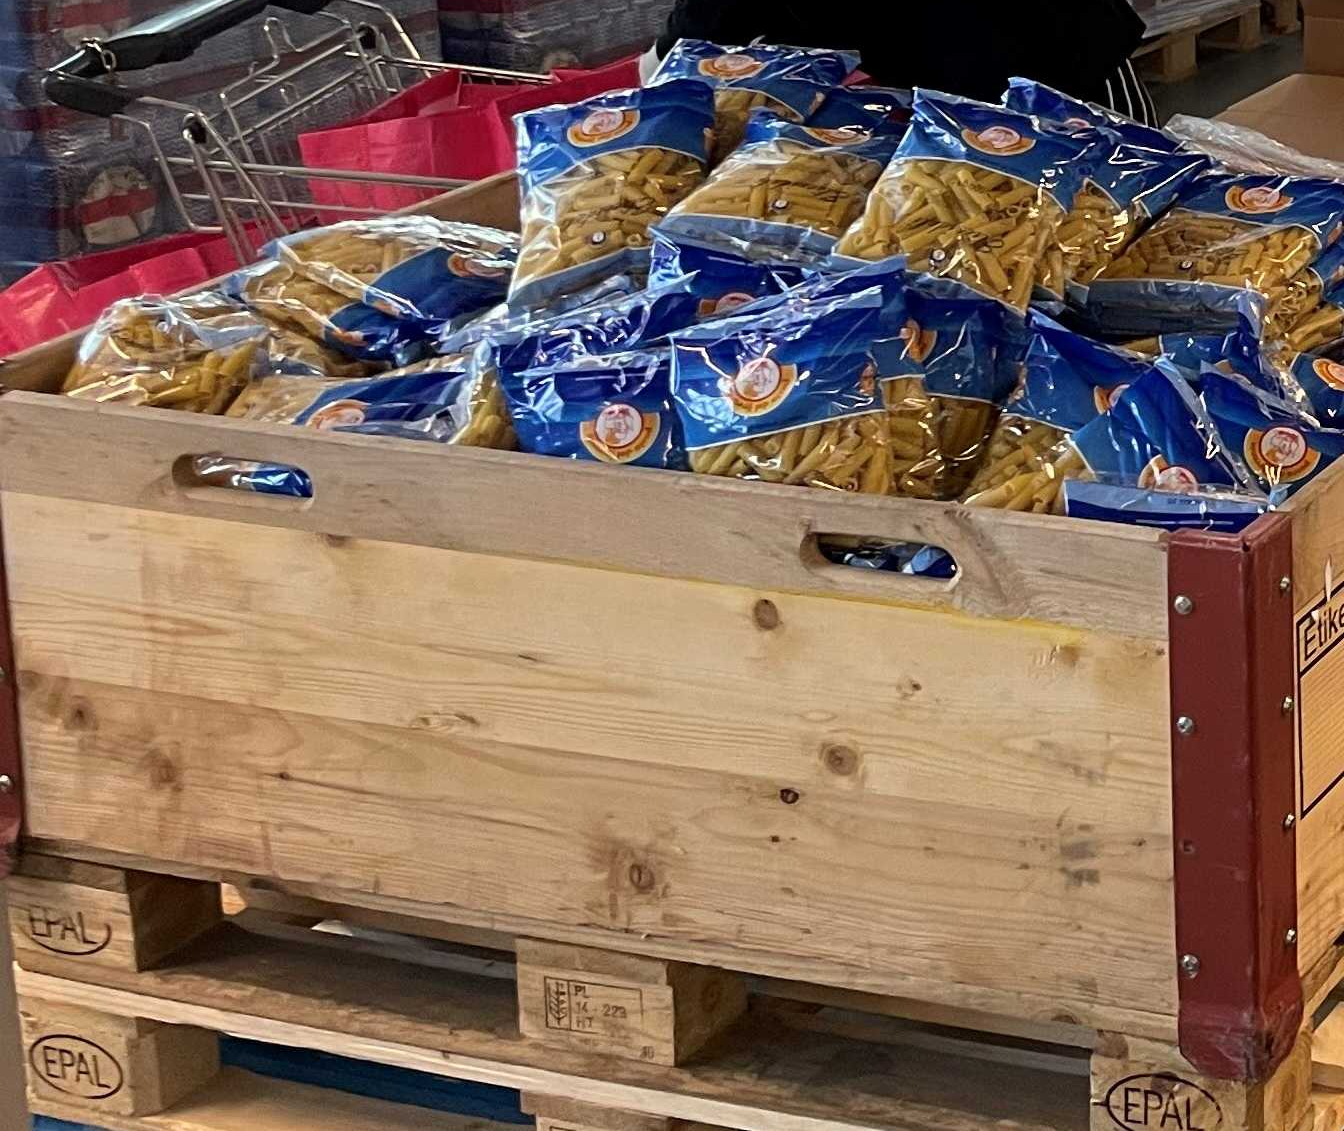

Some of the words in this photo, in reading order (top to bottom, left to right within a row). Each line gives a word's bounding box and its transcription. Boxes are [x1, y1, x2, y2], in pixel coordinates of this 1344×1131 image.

[28, 905, 98, 945] EPAL
[42, 1045, 112, 1089] EPAL
[1124, 1086, 1205, 1131] EPAL
